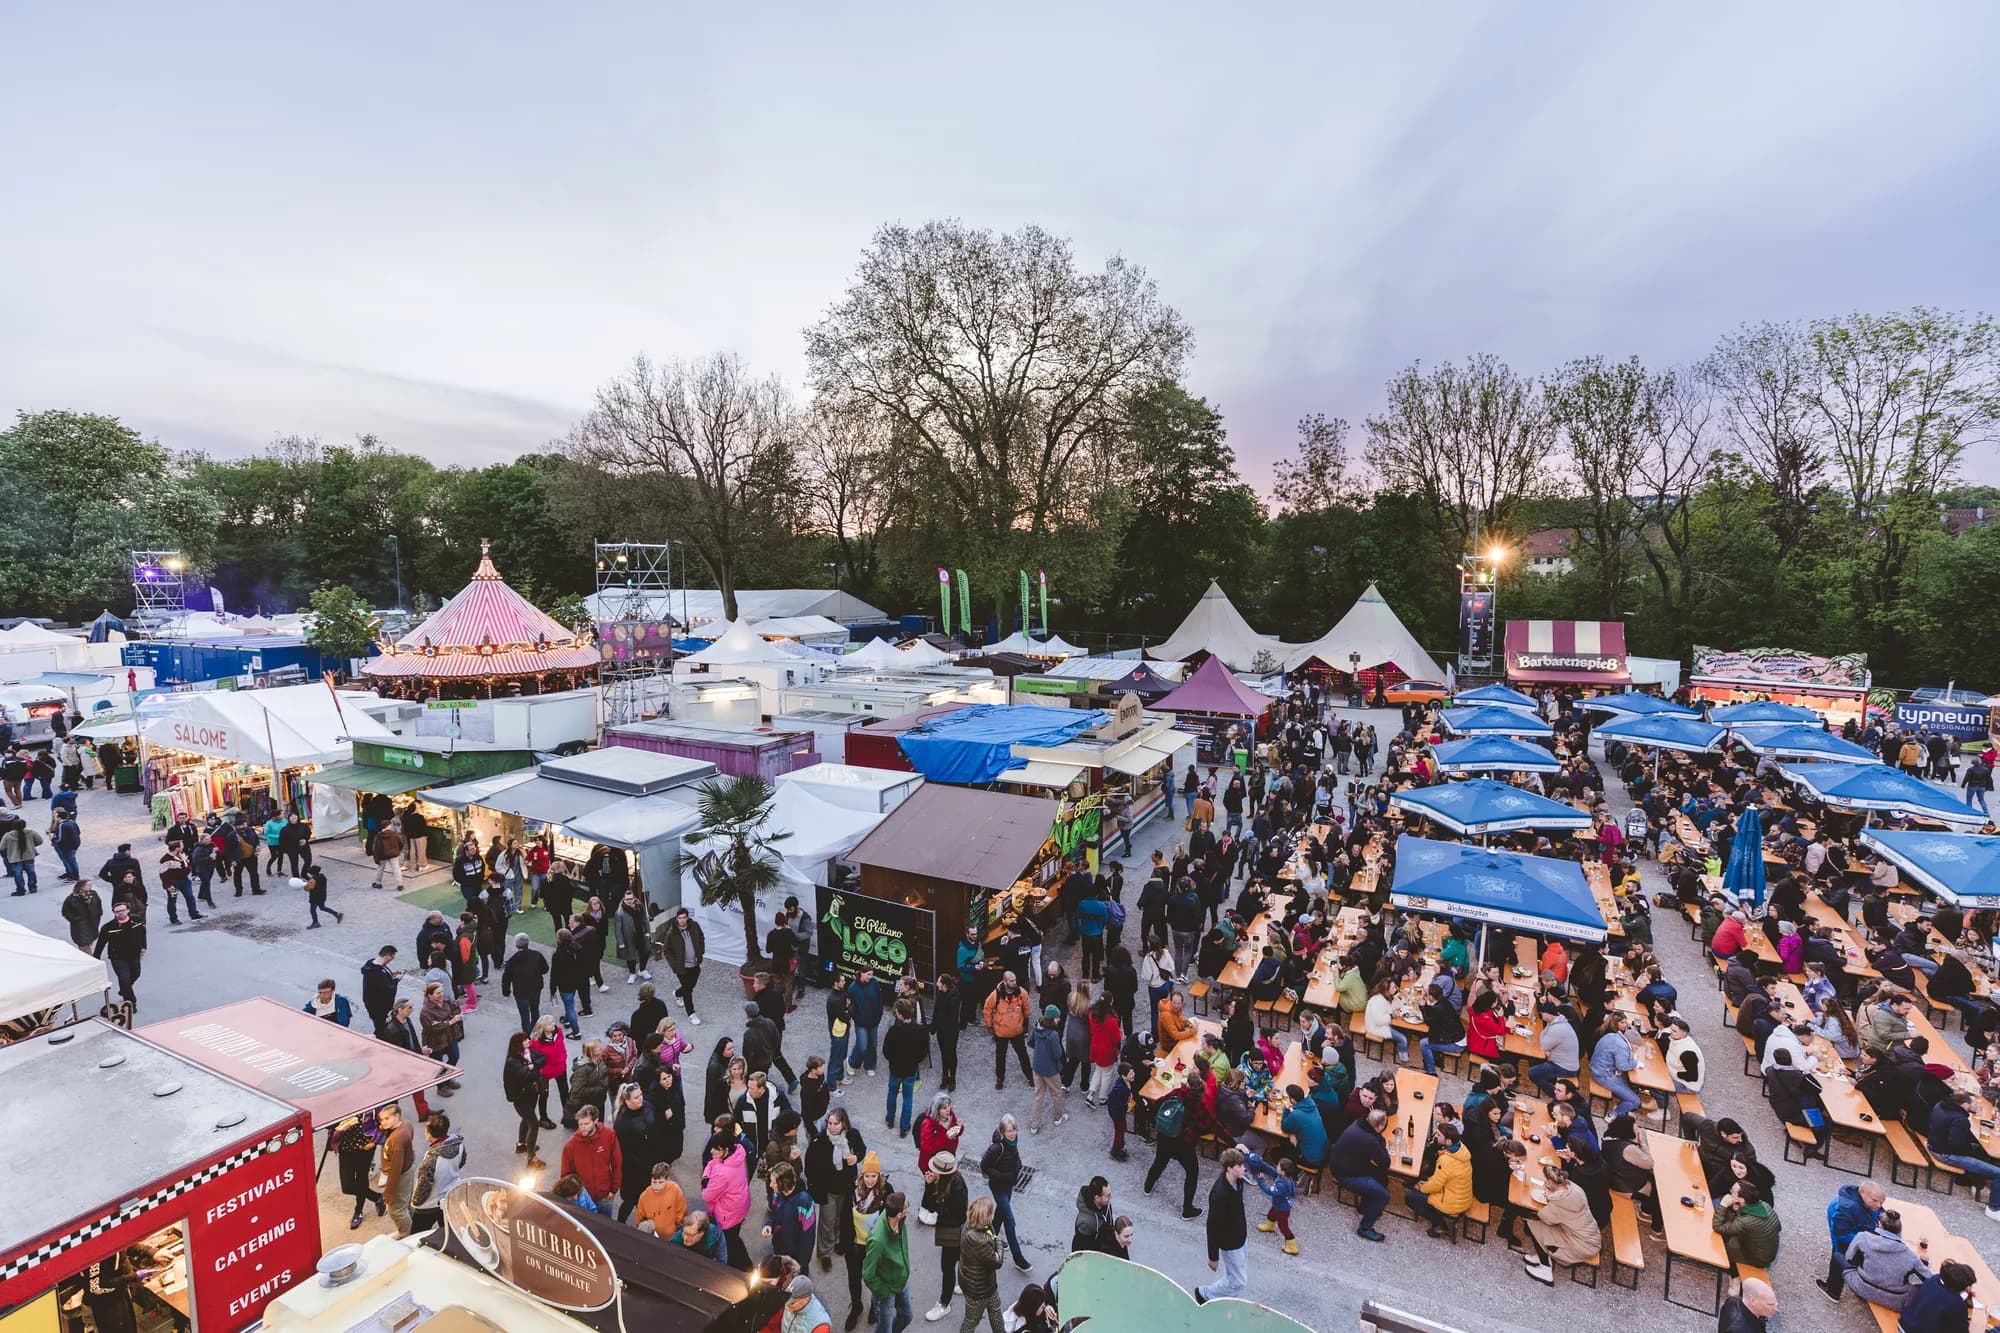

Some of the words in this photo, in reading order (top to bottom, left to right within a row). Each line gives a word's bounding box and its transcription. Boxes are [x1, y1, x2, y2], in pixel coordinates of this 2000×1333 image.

[1519, 655, 1619, 671] Barbarenspieß
[1898, 706, 1985, 726] typneun
[174, 724, 228, 751] SALOME
[842, 925, 908, 965] LOCO
[854, 916, 867, 931] El
[866, 919, 903, 938] Plátano
[206, 1168, 295, 1225] FESTIVALS
[214, 1217, 296, 1273] CATERING
[516, 1218, 597, 1271] CHURROS
[229, 1268, 292, 1317] EVENTS
[525, 1254, 542, 1272] CON
[544, 1264, 592, 1294] CHOCOLATE
